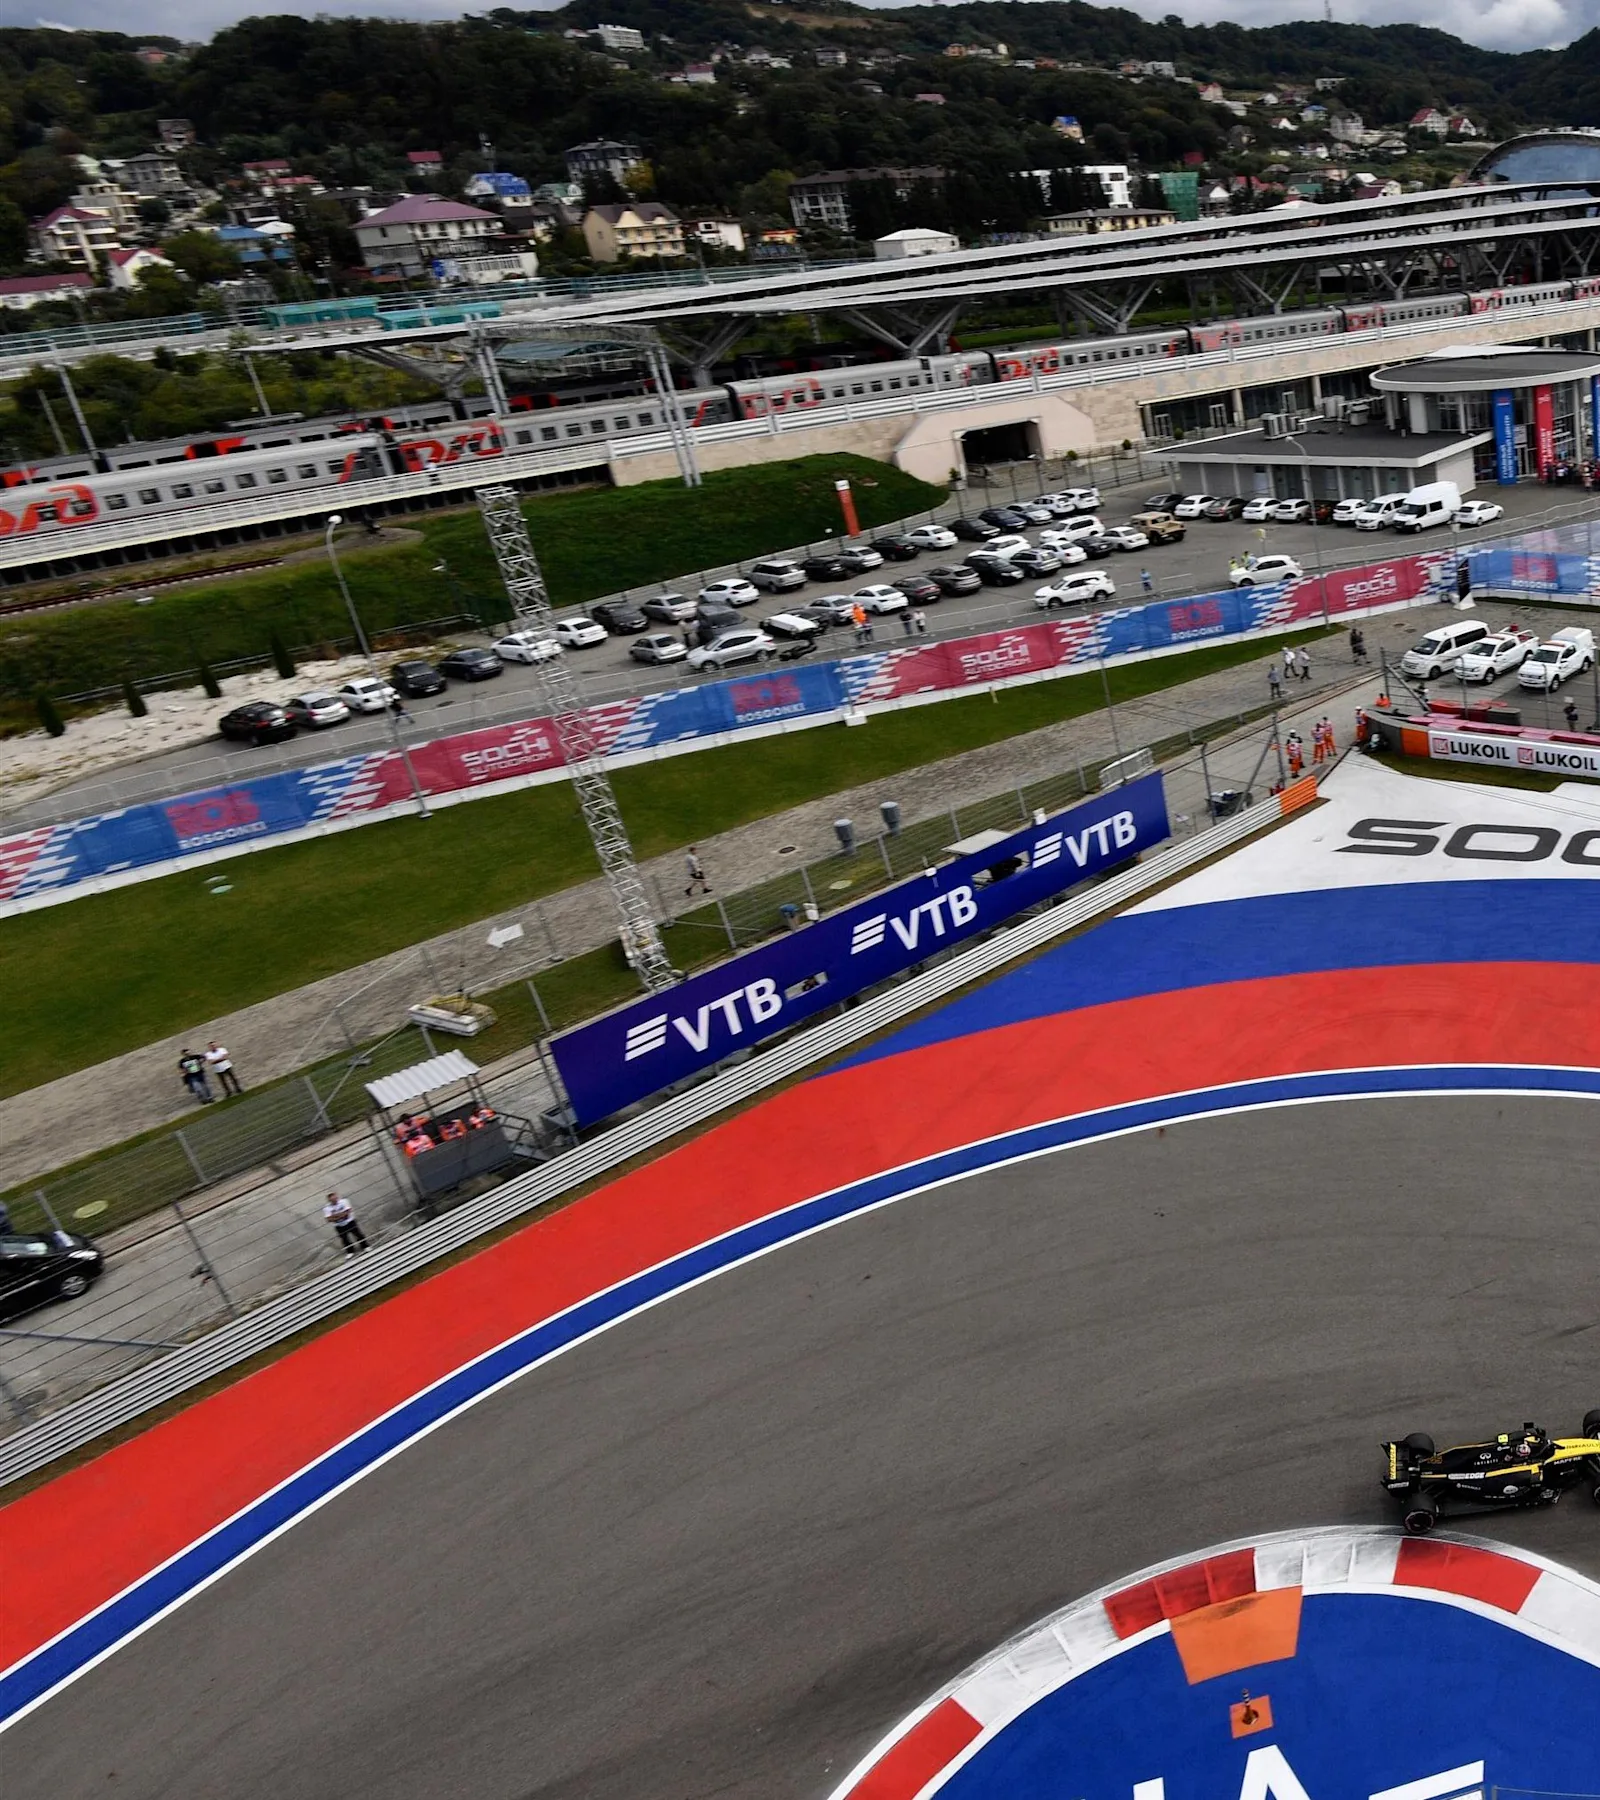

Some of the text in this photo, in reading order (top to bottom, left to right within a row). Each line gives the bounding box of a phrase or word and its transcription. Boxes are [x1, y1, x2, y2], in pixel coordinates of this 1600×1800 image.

[1344, 576, 1396, 594] SOCHI
[1346, 588, 1396, 603] AUTODROM
[1169, 600, 1220, 629] ROS
[1171, 625, 1224, 642] ROSGONKI
[961, 644, 1028, 668] SOCHI
[965, 656, 1031, 675] AUTODROM
[729, 674, 800, 711] ROS
[736, 702, 806, 724] ROSGONKI
[460, 736, 550, 768] SOCHI
[1450, 741, 1510, 760] LUKOIL
[1536, 751, 1597, 771] LUKOIL
[469, 750, 553, 777] AUTODROM
[165, 790, 260, 839] ROS
[178, 820, 267, 850] ROSGONKI
[1064, 810, 1137, 868] VTB
[889, 885, 978, 951] VTB
[671, 977, 783, 1053] VTB
[1465, 1472, 1485, 1480] EDGE
